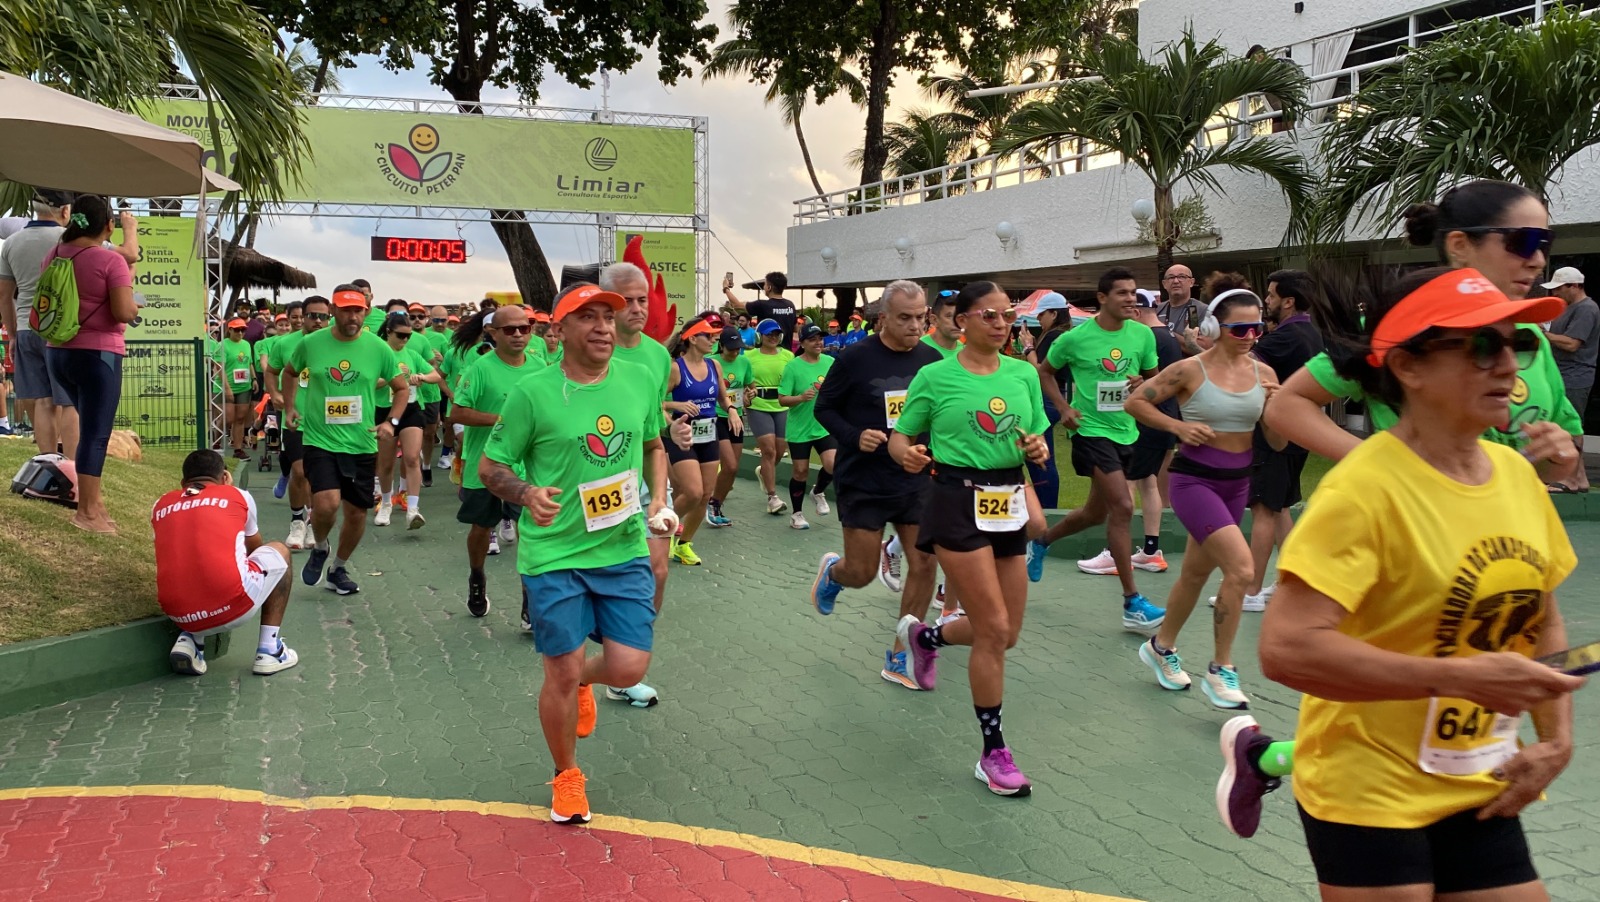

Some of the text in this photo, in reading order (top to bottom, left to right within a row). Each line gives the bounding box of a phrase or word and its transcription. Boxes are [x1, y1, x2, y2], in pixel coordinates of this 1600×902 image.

[377, 157, 418, 195] CIRCUITO
[426, 174, 456, 195] PETER
[452, 153, 466, 175] PAN
[557, 174, 645, 193] Limiar
[386, 238, 464, 261] 0:00:05
[144, 318, 182, 328] Lopes
[1100, 391, 1122, 402] 715
[327, 405, 349, 415] 648
[692, 425, 708, 435] 754
[580, 445, 606, 468] CIRCUITO
[611, 448, 627, 466] PETER
[625, 431, 633, 448] PAN
[587, 490, 622, 513] 193
[978, 499, 1009, 515] 524
[1437, 707, 1495, 741] 647
